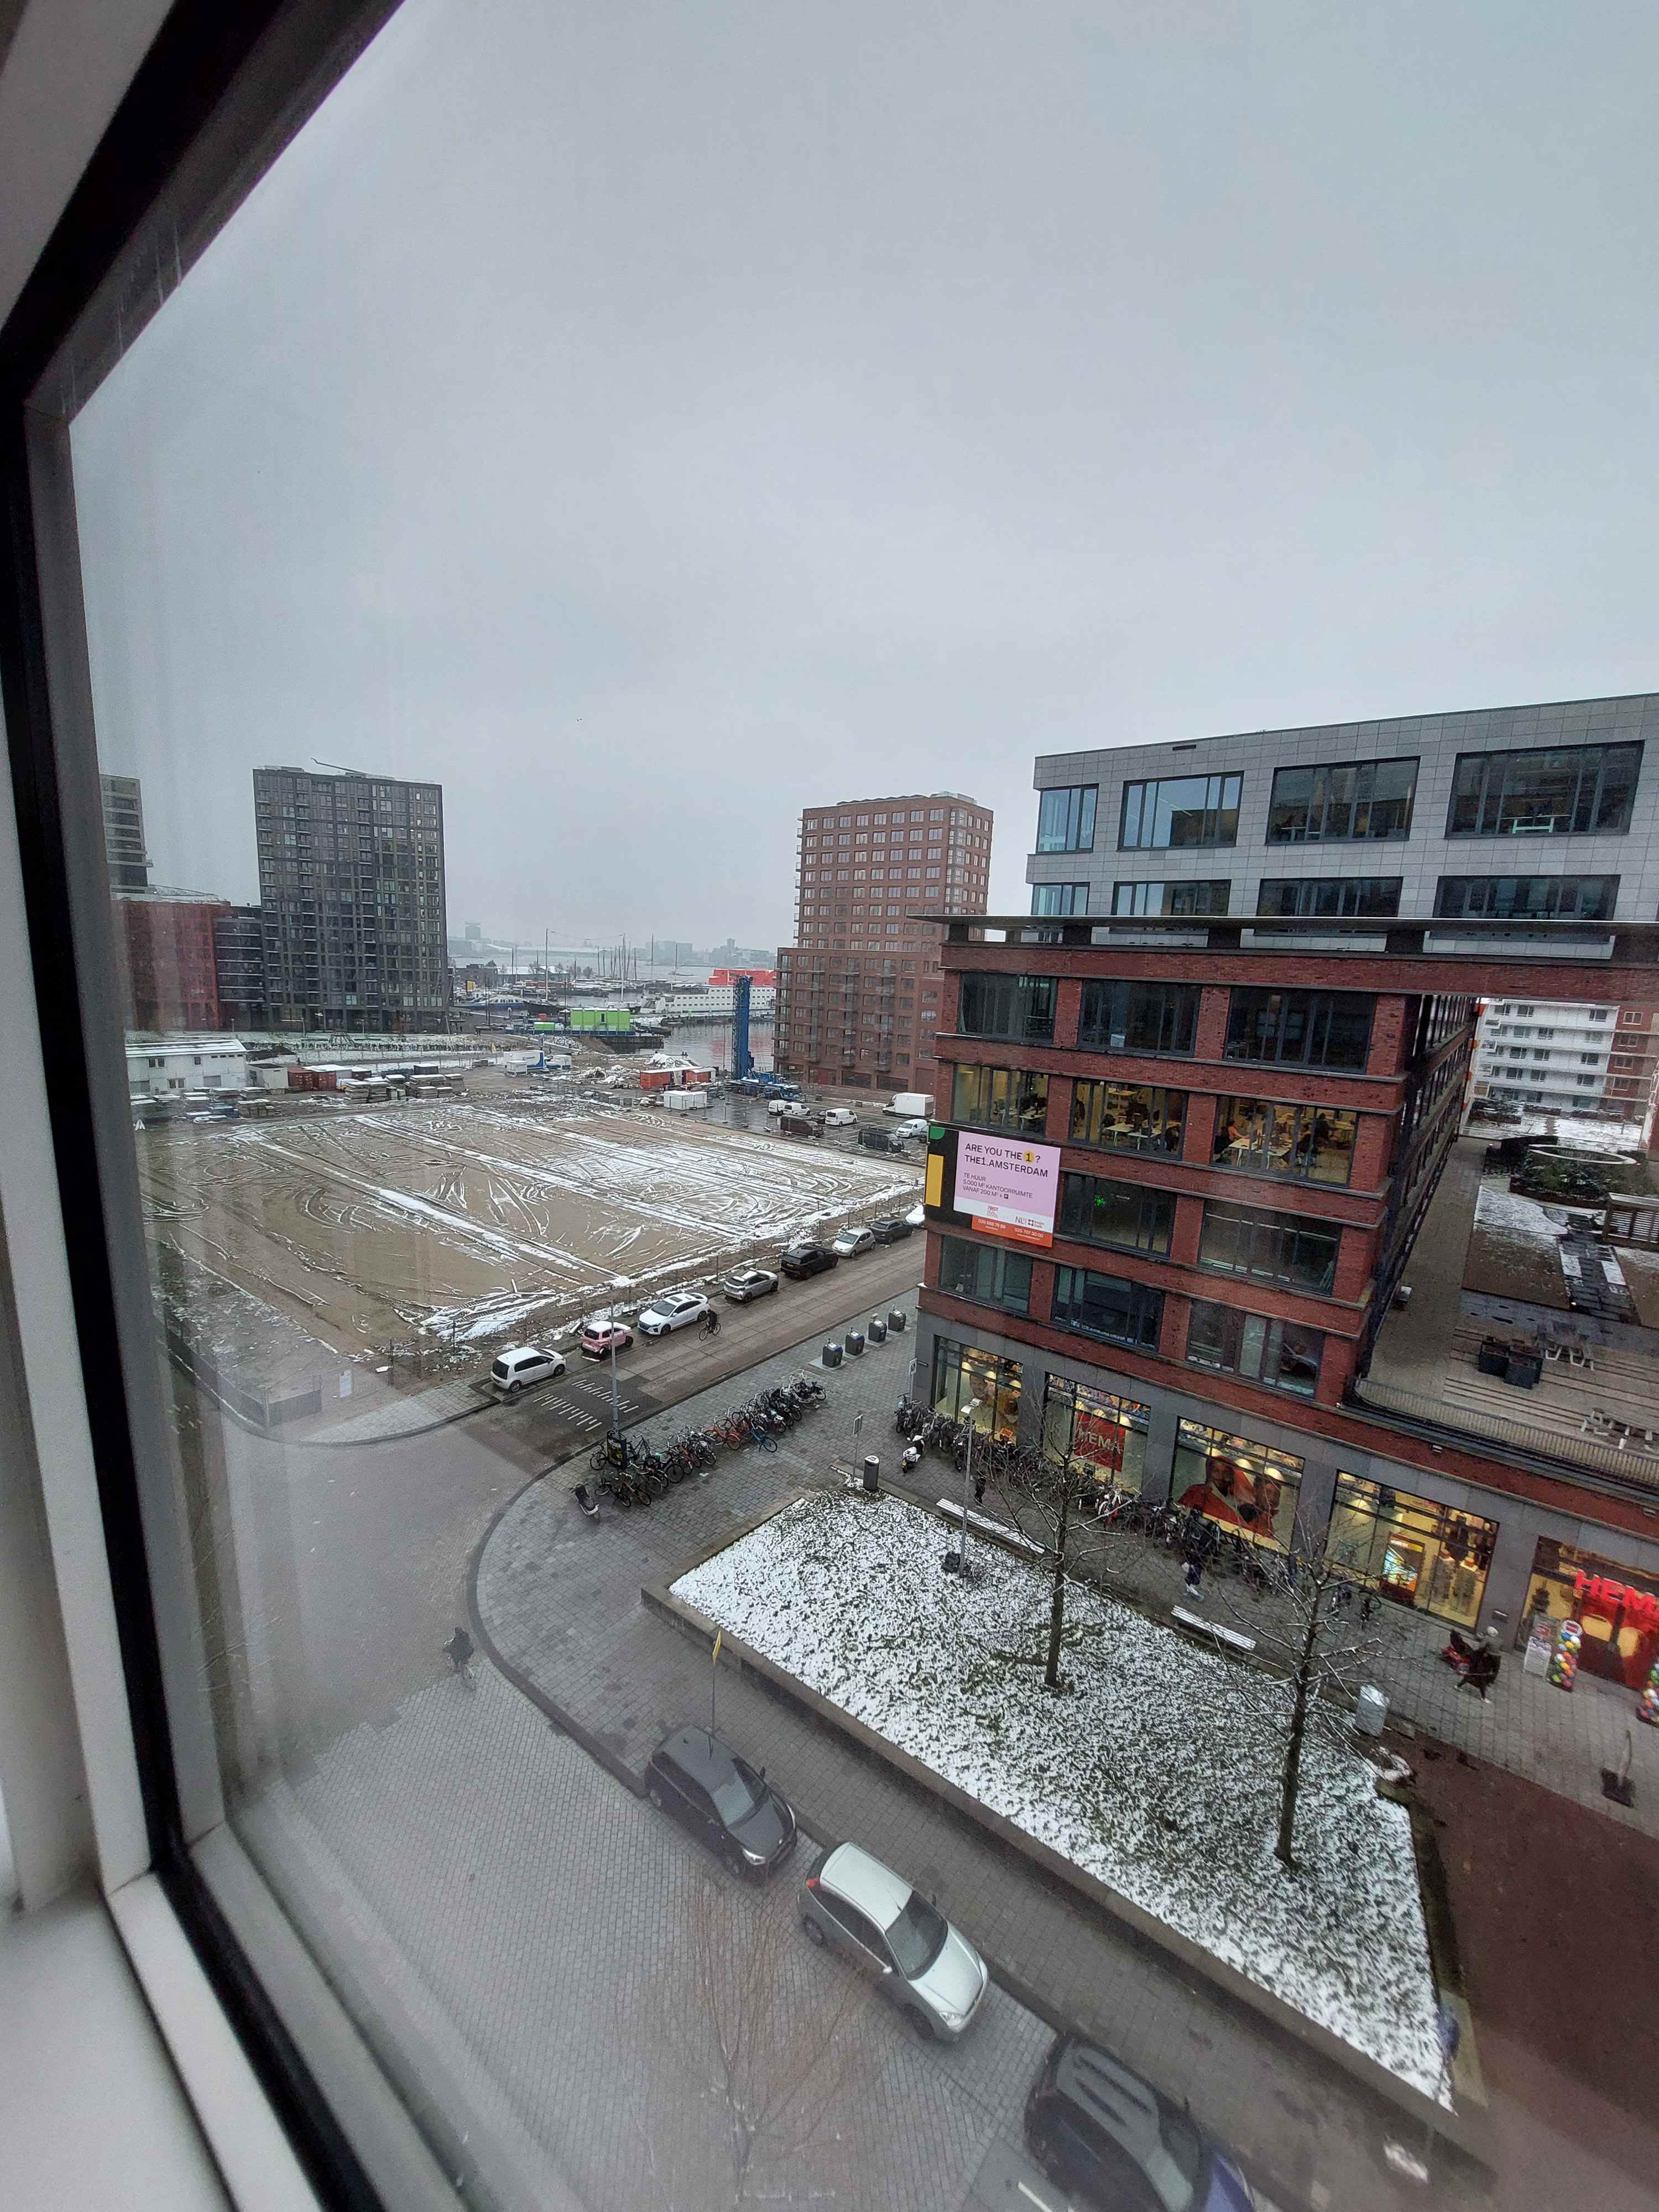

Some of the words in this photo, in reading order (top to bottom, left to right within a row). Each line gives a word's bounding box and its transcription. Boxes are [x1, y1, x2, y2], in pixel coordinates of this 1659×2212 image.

[965, 1143, 983, 1153] ARE
[984, 1146, 1003, 1156] YOU
[1004, 1150, 1022, 1160] THE
[1025, 1152, 1032, 1162] 1
[964, 1155, 1048, 1177] THE1.AMSTERDAM
